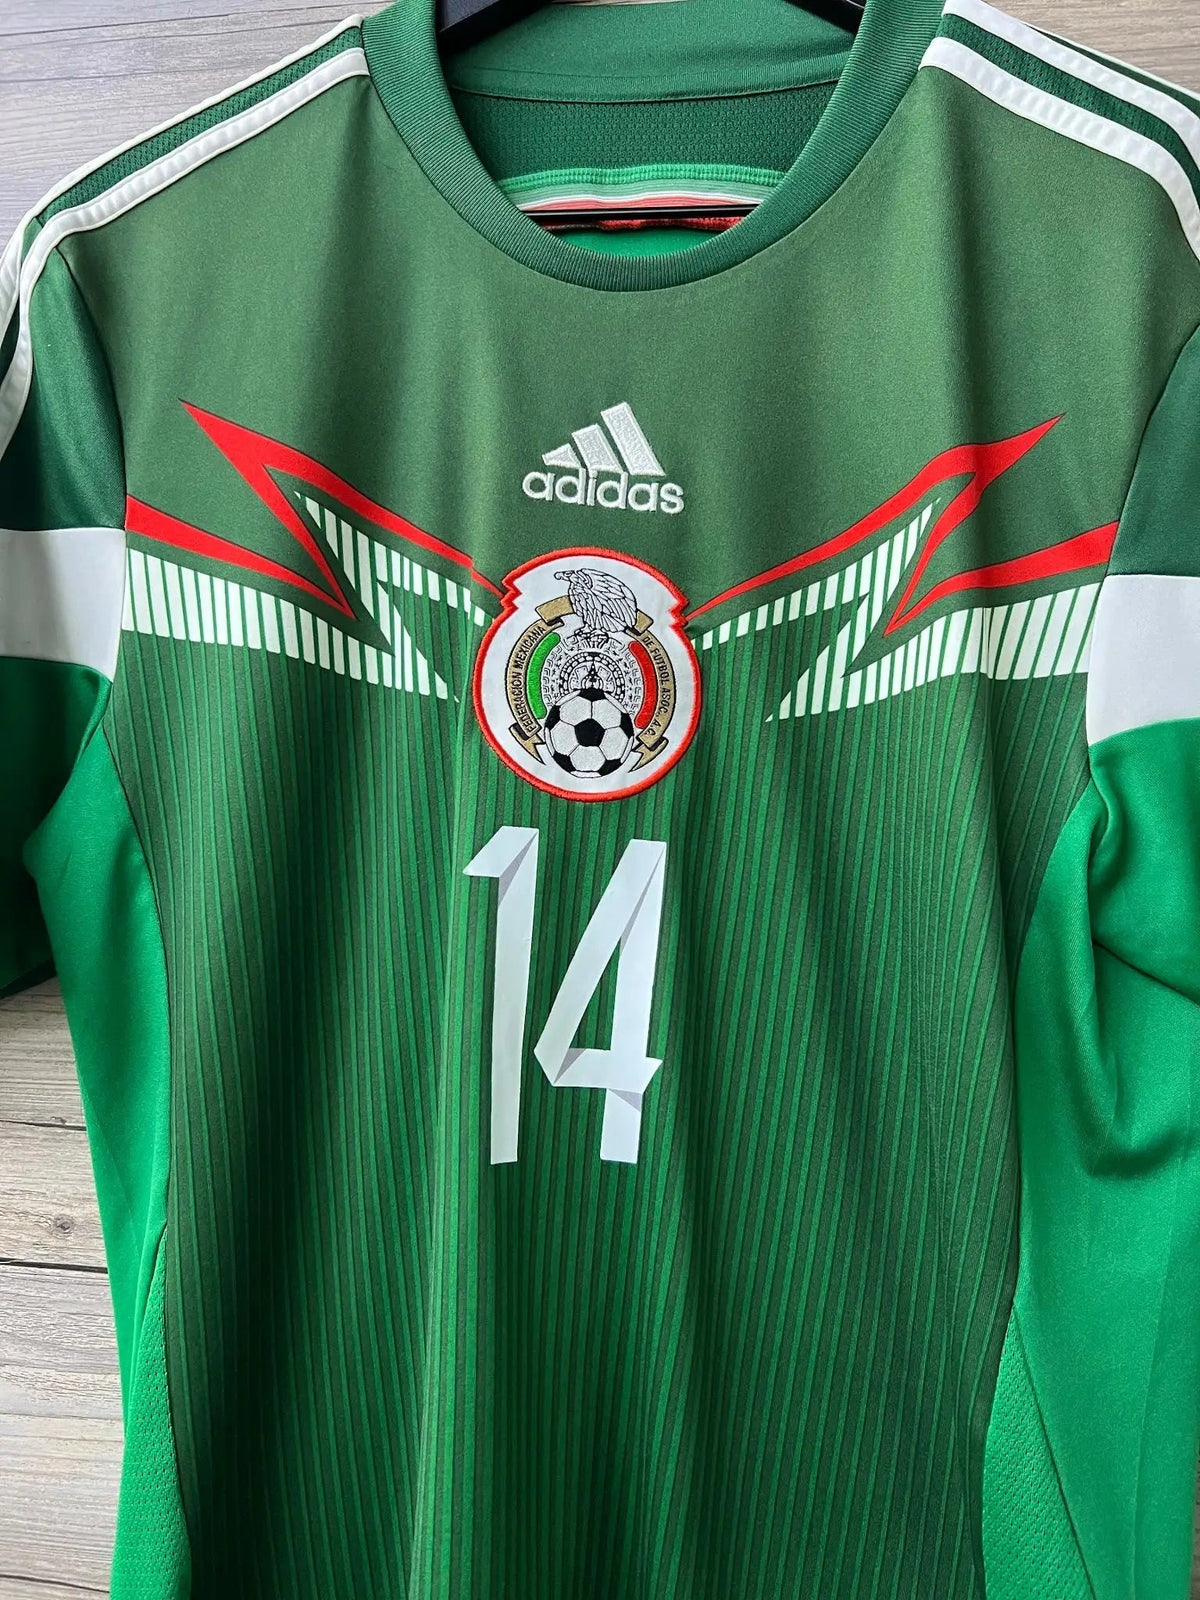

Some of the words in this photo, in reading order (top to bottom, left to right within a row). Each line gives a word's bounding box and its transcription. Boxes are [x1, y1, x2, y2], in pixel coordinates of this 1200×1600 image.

[522, 467, 685, 514] adidas
[514, 625, 547, 669] MEXICANA
[641, 635, 655, 648] DE
[650, 647, 671, 686] FUTBOL
[511, 671, 537, 733] FEDERACION
[462, 825, 667, 1165] 14
